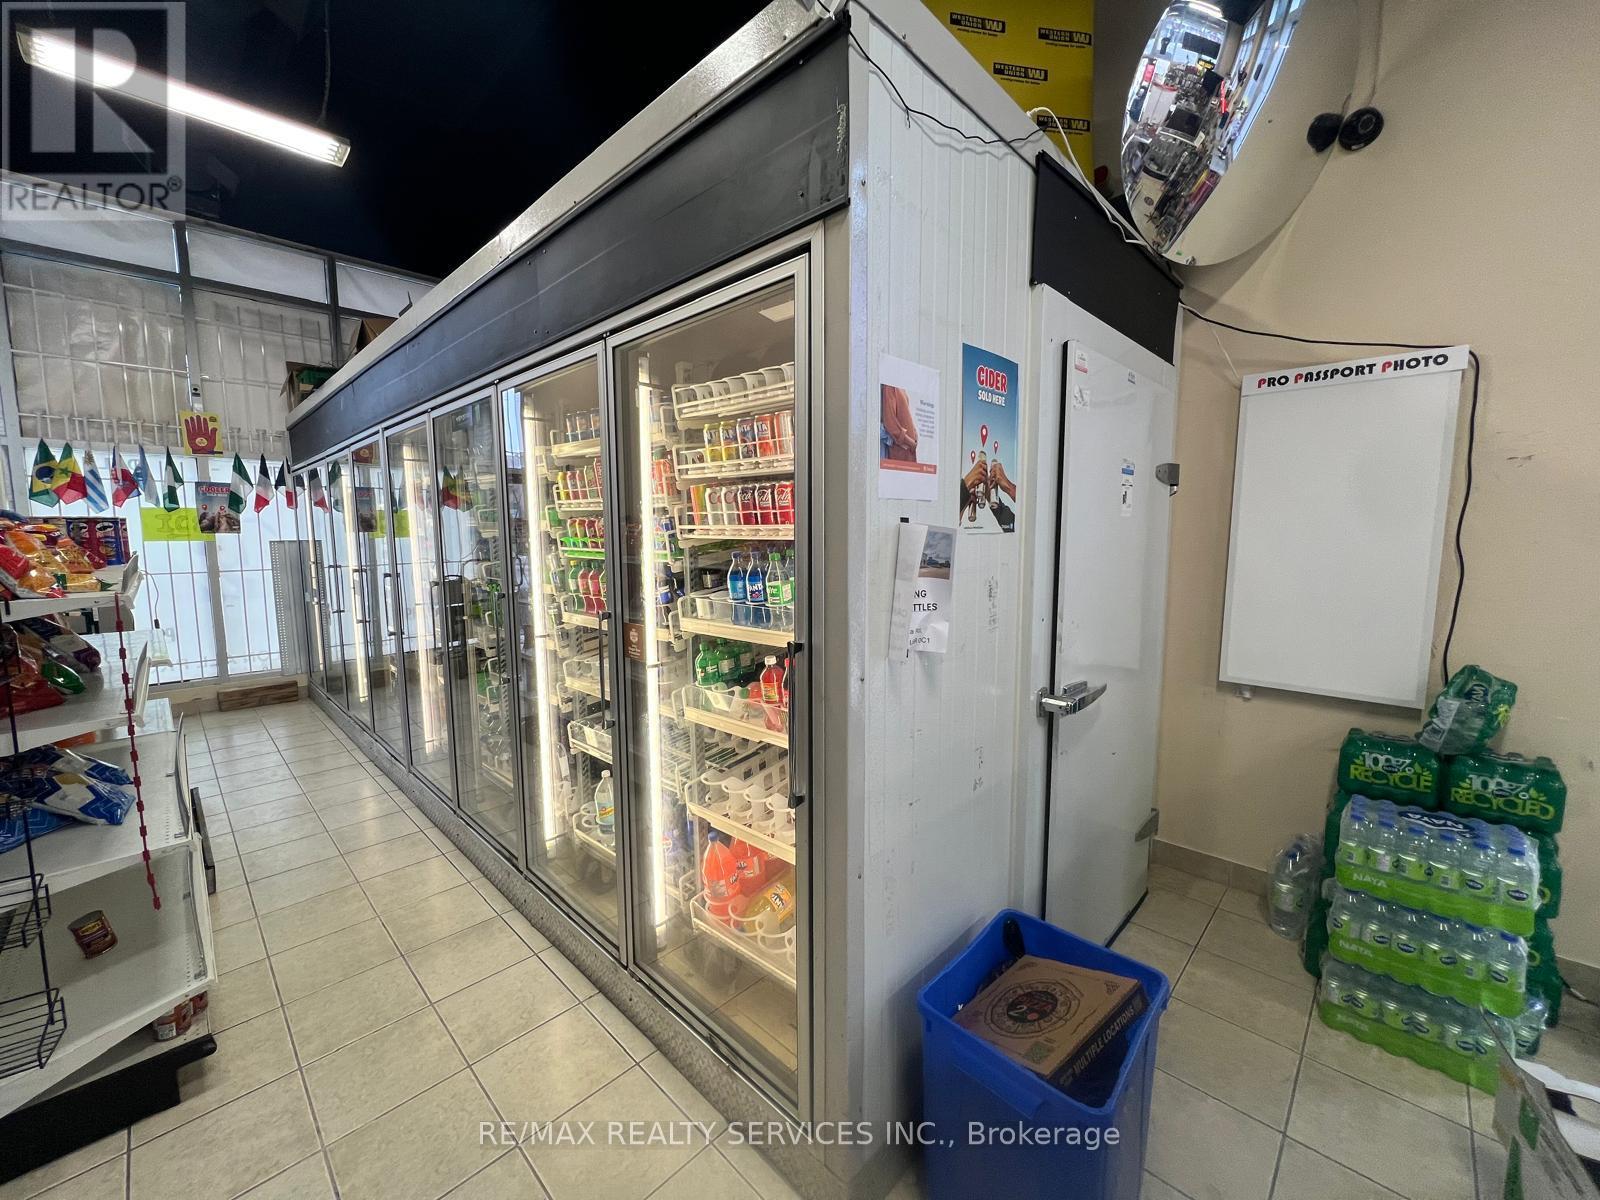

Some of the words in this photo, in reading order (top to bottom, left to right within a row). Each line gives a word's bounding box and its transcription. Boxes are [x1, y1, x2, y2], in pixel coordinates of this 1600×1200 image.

[952, 14, 982, 23] WESTERN
[961, 20, 982, 29] UNION
[985, 20, 1003, 32] WU
[1040, 28, 1070, 36] WESTERN
[1073, 32, 1090, 43] WU
[995, 63, 1025, 72] WESTERN
[1028, 68, 1045, 80] WU
[1071, 119, 1088, 130] WU
[1257, 375, 1290, 389] PRO
[1294, 363, 1376, 384] PASSPORT
[1381, 353, 1449, 373] PHOTO
[977, 365, 1007, 394] CIDER
[977, 389, 992, 403] SOLD
[992, 394, 1006, 407] HERE
[914, 589, 927, 598] NG
[913, 602, 938, 612] TTLES
[1451, 787, 1556, 820] RECYCLED
[1353, 872, 1387, 888] NAYA
[1103, 1005, 1134, 1043] LOCATIONS
